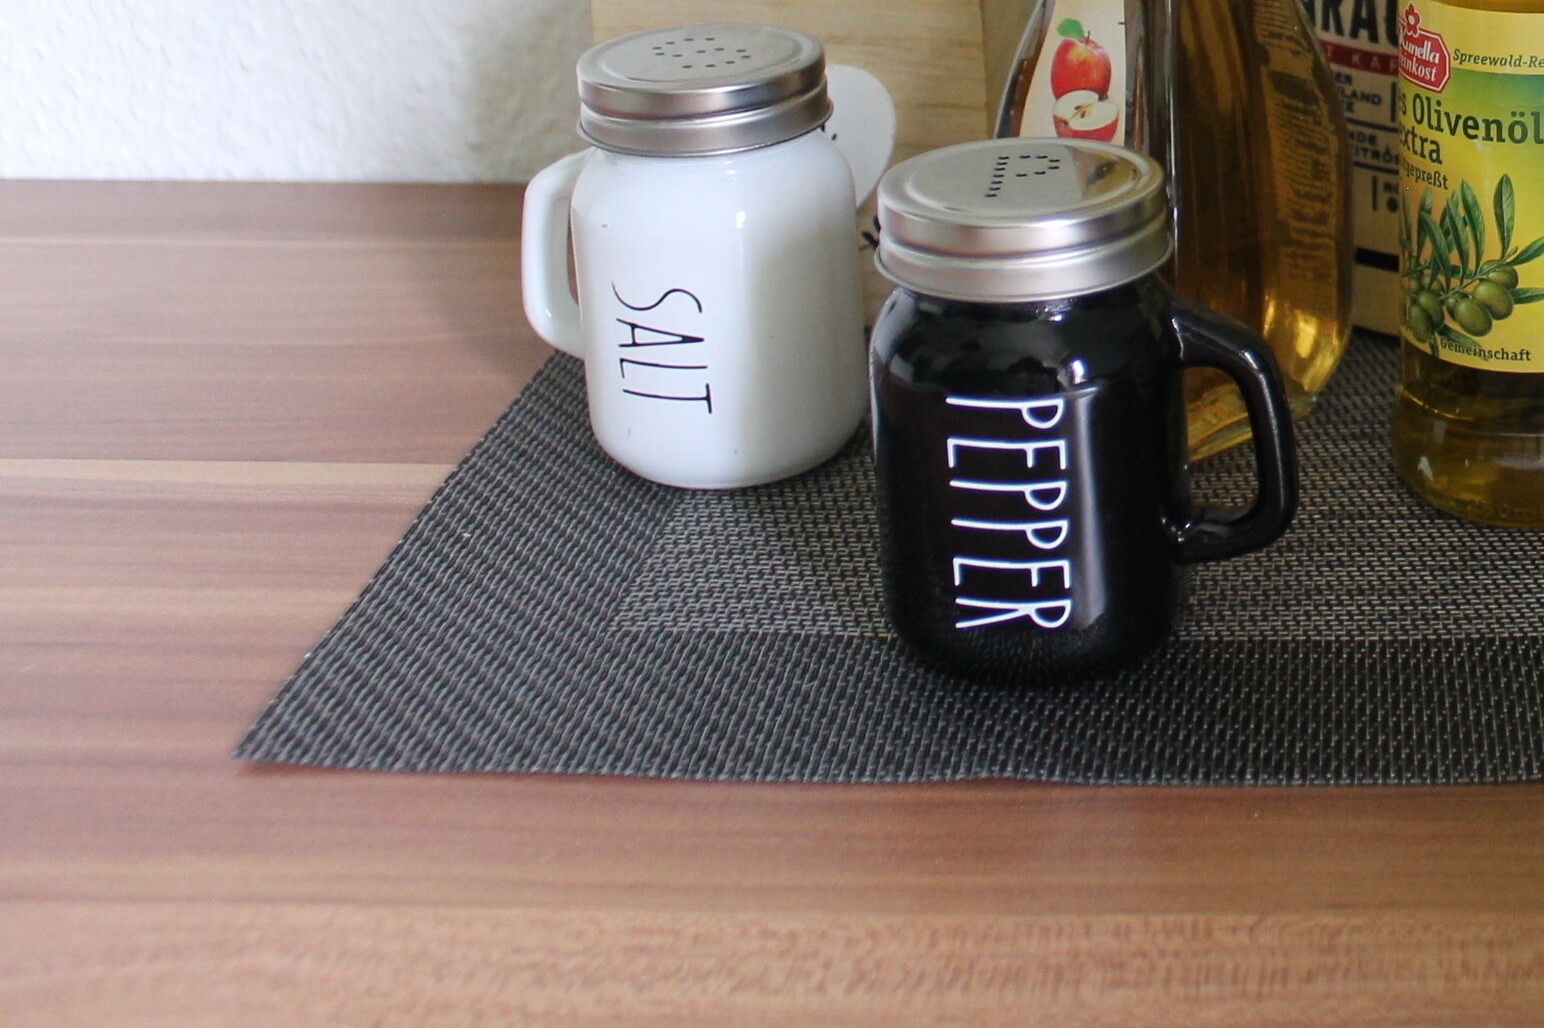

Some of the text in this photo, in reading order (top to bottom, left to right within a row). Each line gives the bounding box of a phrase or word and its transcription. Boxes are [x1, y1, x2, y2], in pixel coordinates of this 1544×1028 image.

[1412, 92, 1544, 146] Olivenöl
[611, 281, 713, 415] SALT
[1440, 336, 1532, 362] Gemeinschaft
[945, 396, 1073, 629] PEPPER
